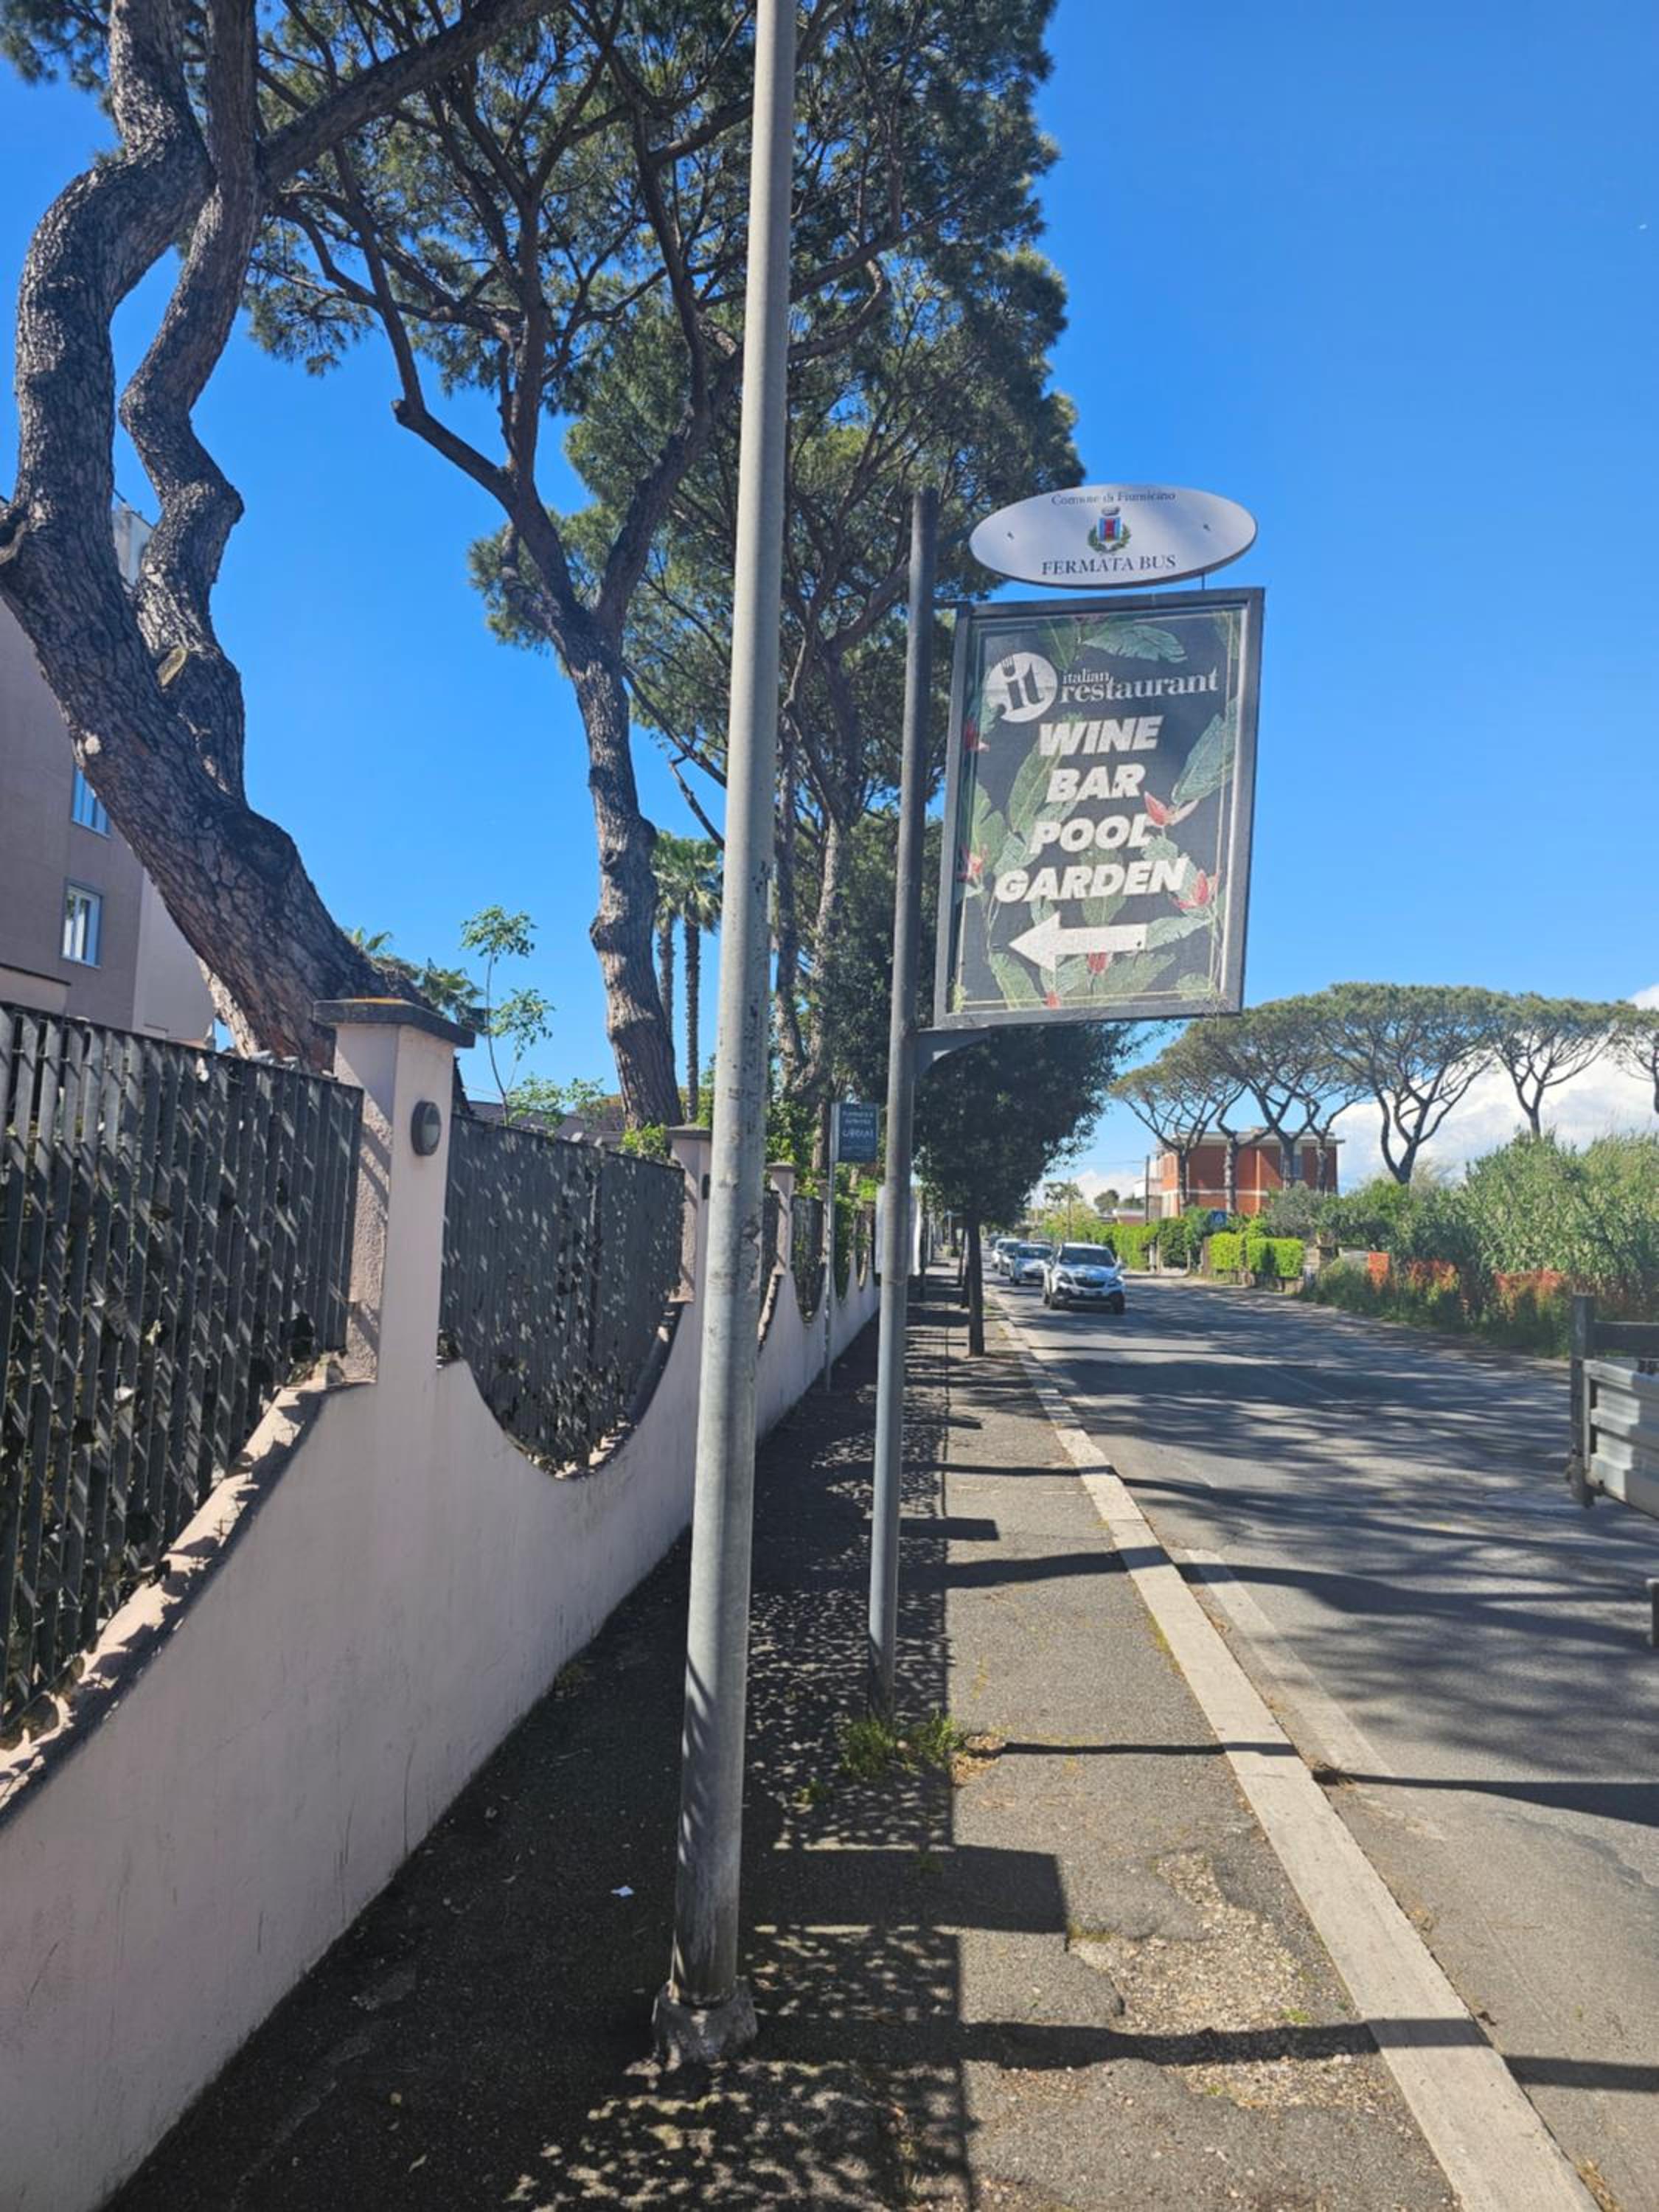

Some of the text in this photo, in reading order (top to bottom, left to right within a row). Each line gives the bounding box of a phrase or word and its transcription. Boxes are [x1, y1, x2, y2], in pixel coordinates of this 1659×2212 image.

[1041, 554, 1177, 576] FERMATA BUS
[1060, 667, 1219, 703] restaurant
[1062, 669, 1109, 684] italian
[1039, 715, 1164, 756] WINE
[1046, 763, 1145, 803] BAR
[1029, 814, 1153, 853] POOL
[995, 858, 1189, 902] GARDEN
